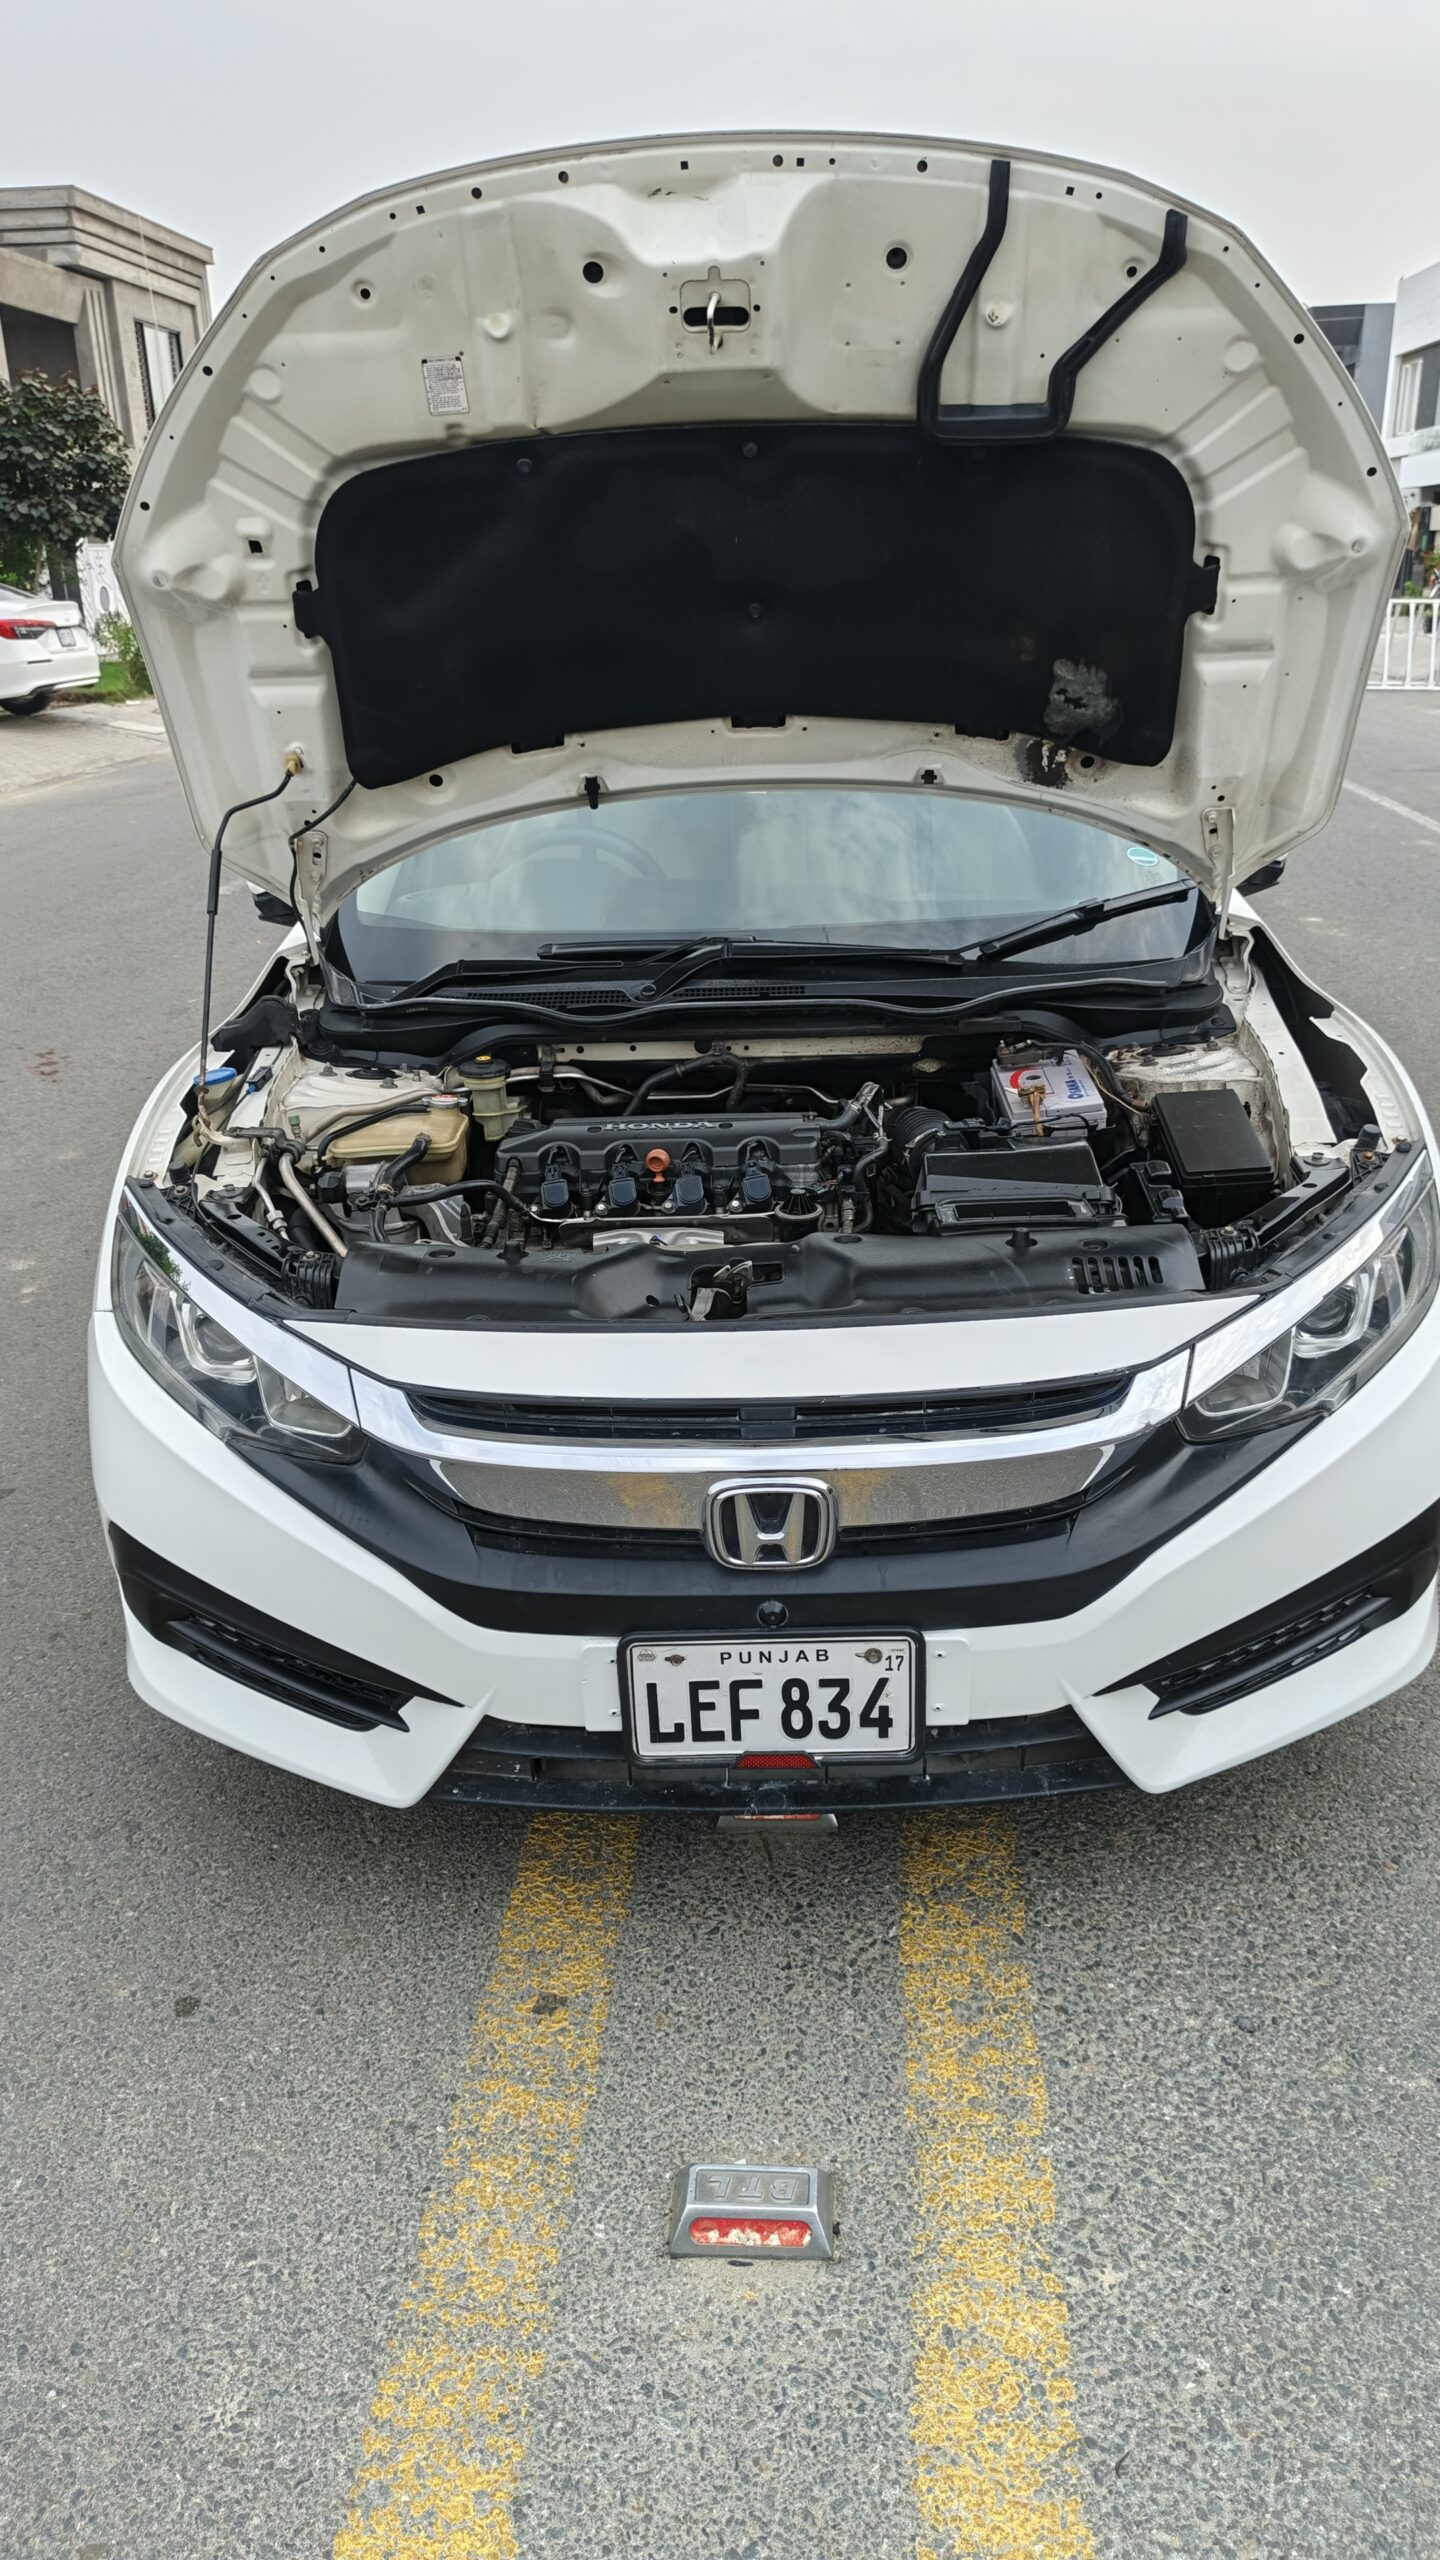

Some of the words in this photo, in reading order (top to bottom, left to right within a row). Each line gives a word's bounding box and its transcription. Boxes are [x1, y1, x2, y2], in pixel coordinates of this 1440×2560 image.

[603, 1119, 716, 1132] HONDA
[719, 1648, 830, 1665] PUNJAB
[885, 1655, 904, 1671] 17
[646, 1678, 763, 1744] LEF
[780, 1677, 893, 1740] 834
[708, 2175, 798, 2200] BTL
